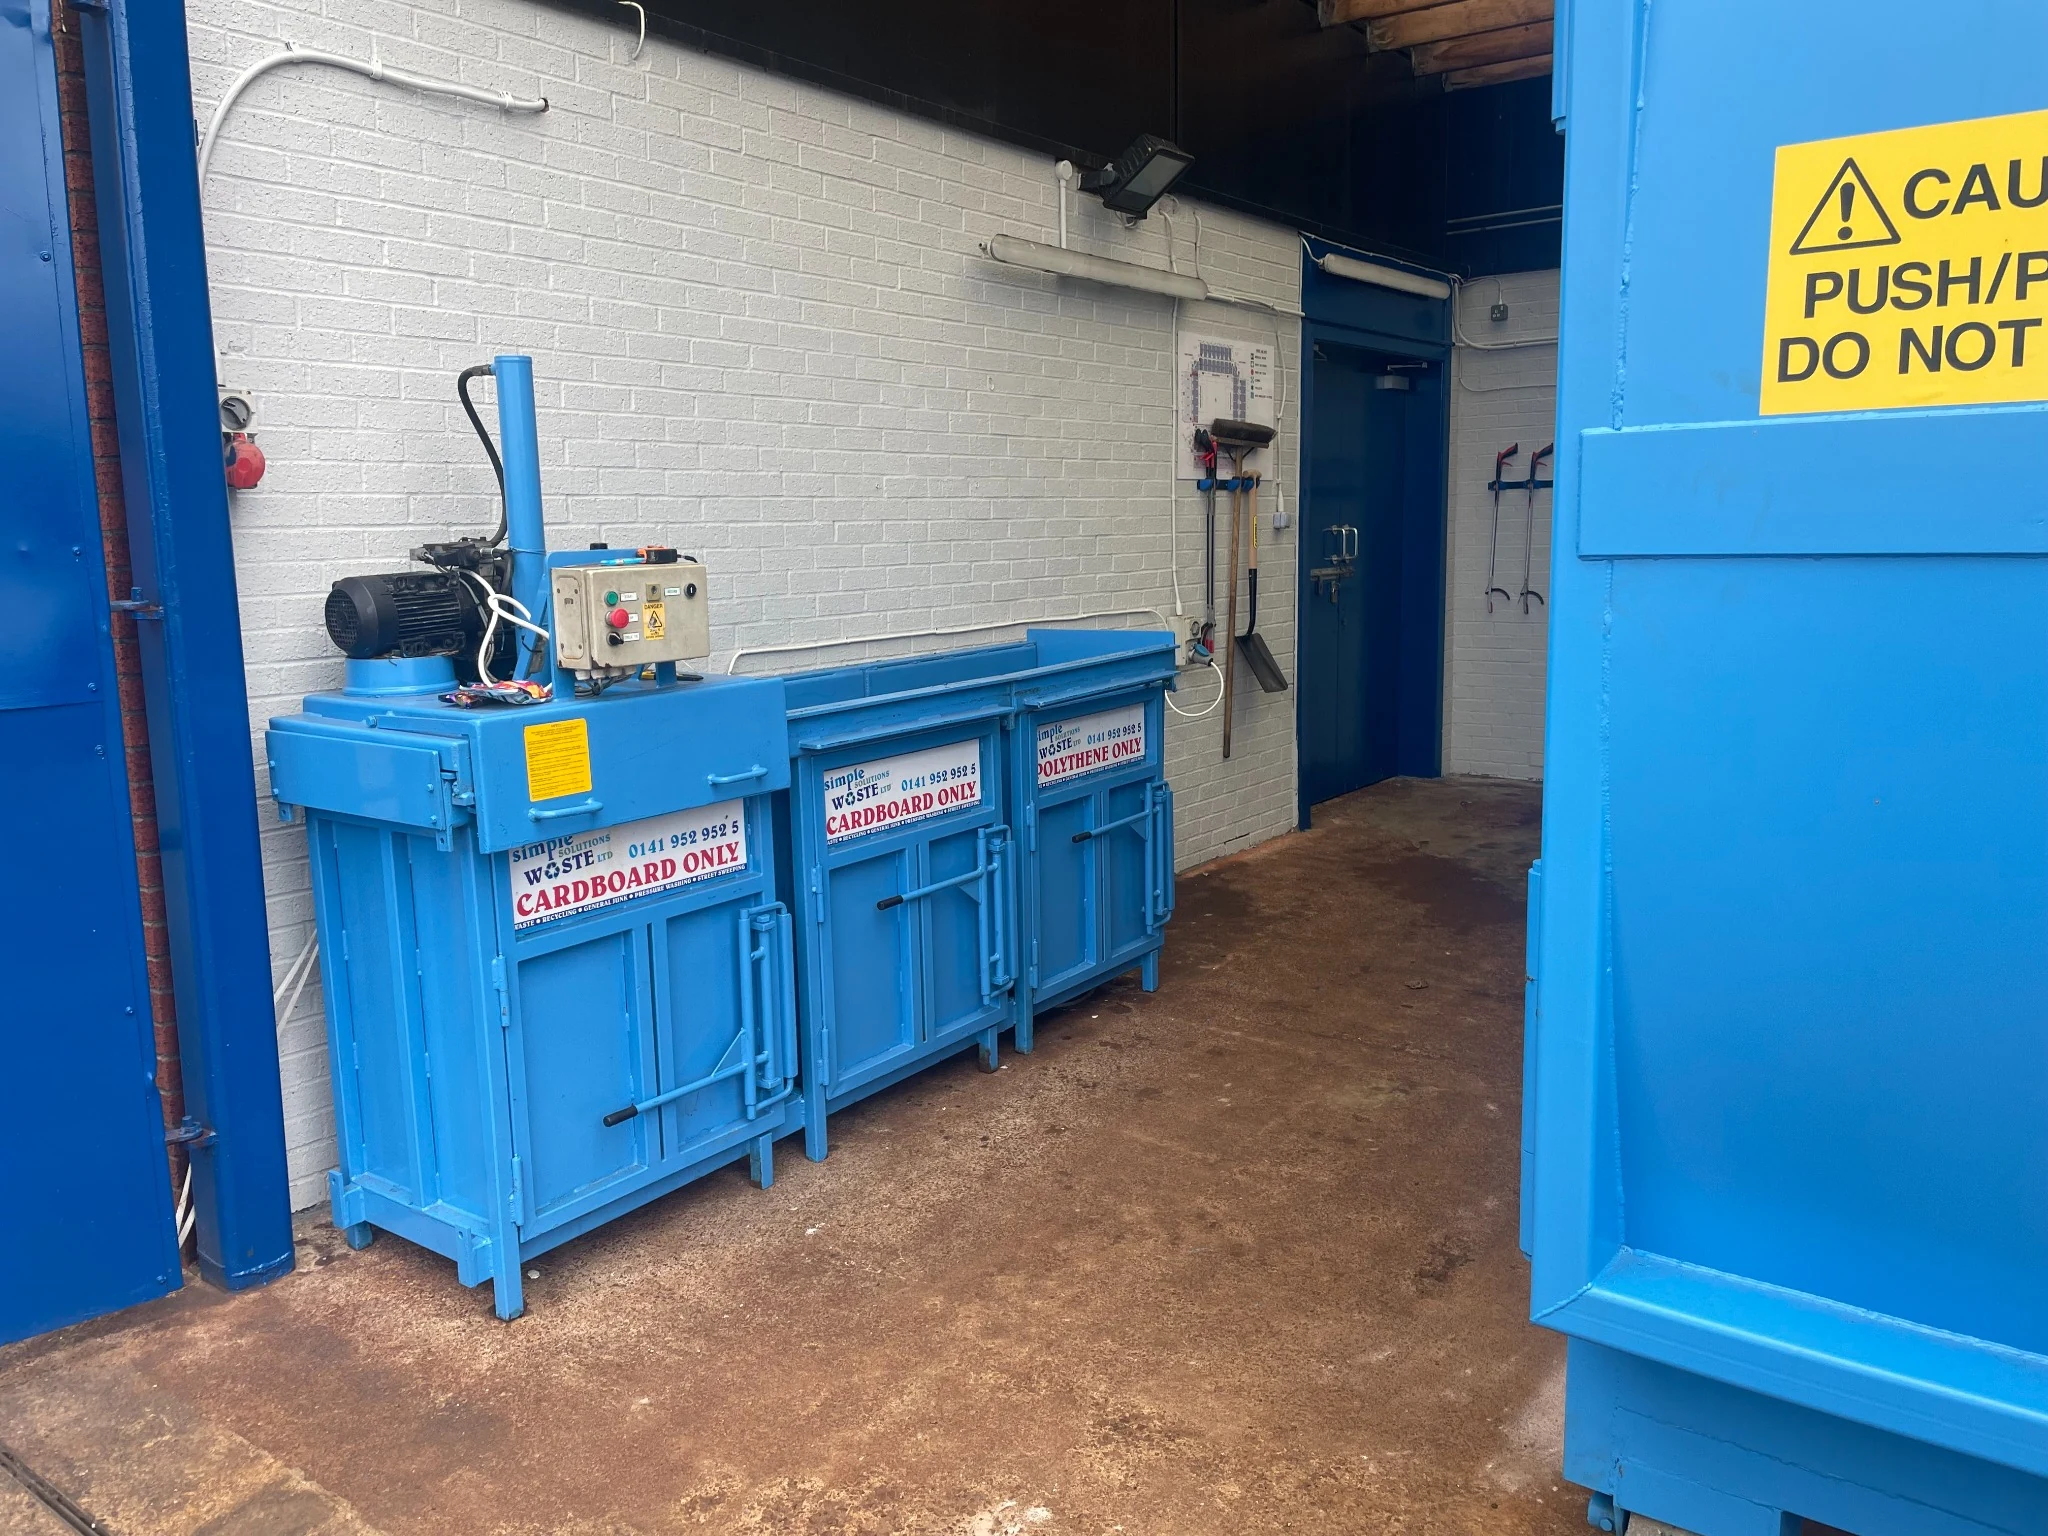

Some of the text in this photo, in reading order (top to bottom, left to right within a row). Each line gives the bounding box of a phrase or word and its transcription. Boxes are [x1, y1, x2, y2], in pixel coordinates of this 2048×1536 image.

[1777, 318, 2042, 383] DO NOT
[1087, 722, 1141, 745] 0141 952 952 5
[1112, 737, 1141, 758] ONLY
[824, 768, 864, 791] simple
[855, 770, 889, 788] SOLUTIONS
[901, 762, 976, 791] 0141 952 952 5
[880, 784, 892, 793] LTD
[827, 792, 933, 835] CARDBOARD
[938, 781, 976, 806] ONLY
[559, 834, 611, 857] SOLUTIONS
[629, 820, 739, 858] 0141 952 952 5
[597, 851, 613, 862] LTD
[517, 841, 739, 916] CARDBOARD ONLY
[542, 909, 577, 923] RECYCLING
[584, 900, 611, 912] GENERAL
[634, 885, 664, 898] PRESSURE
